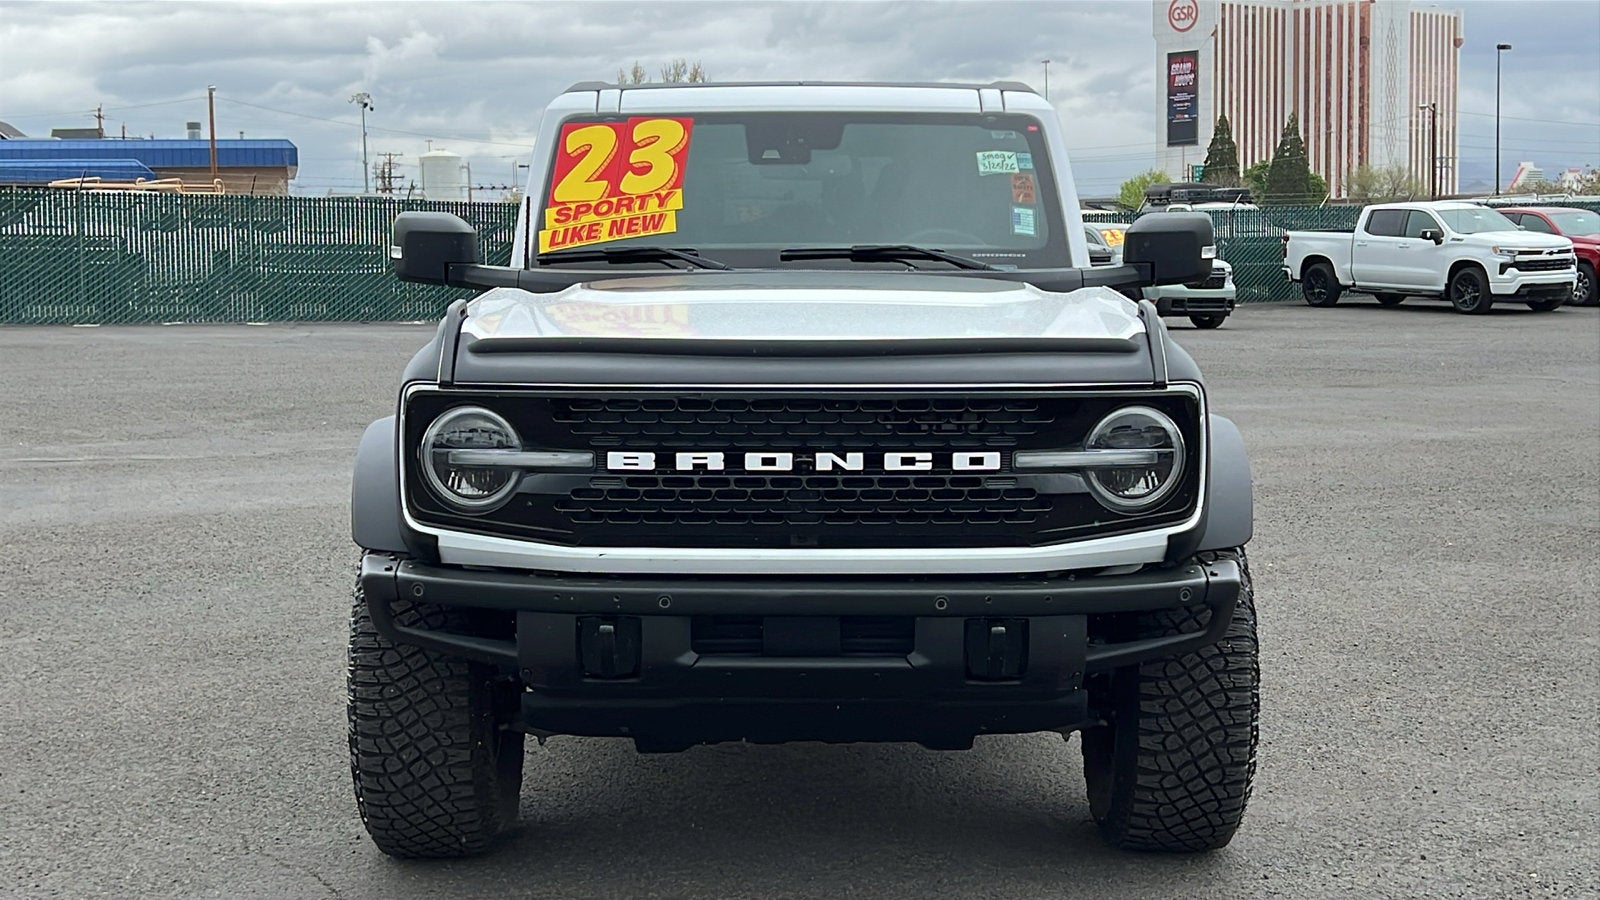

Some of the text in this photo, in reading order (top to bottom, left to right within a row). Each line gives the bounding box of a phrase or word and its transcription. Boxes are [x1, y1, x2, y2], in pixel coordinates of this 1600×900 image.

[1172, 5, 1193, 21] GSR
[553, 118, 688, 202] 23
[554, 191, 677, 224] SPORTY
[549, 213, 667, 248] LIKE NEW
[606, 451, 1001, 471] BRONCO
